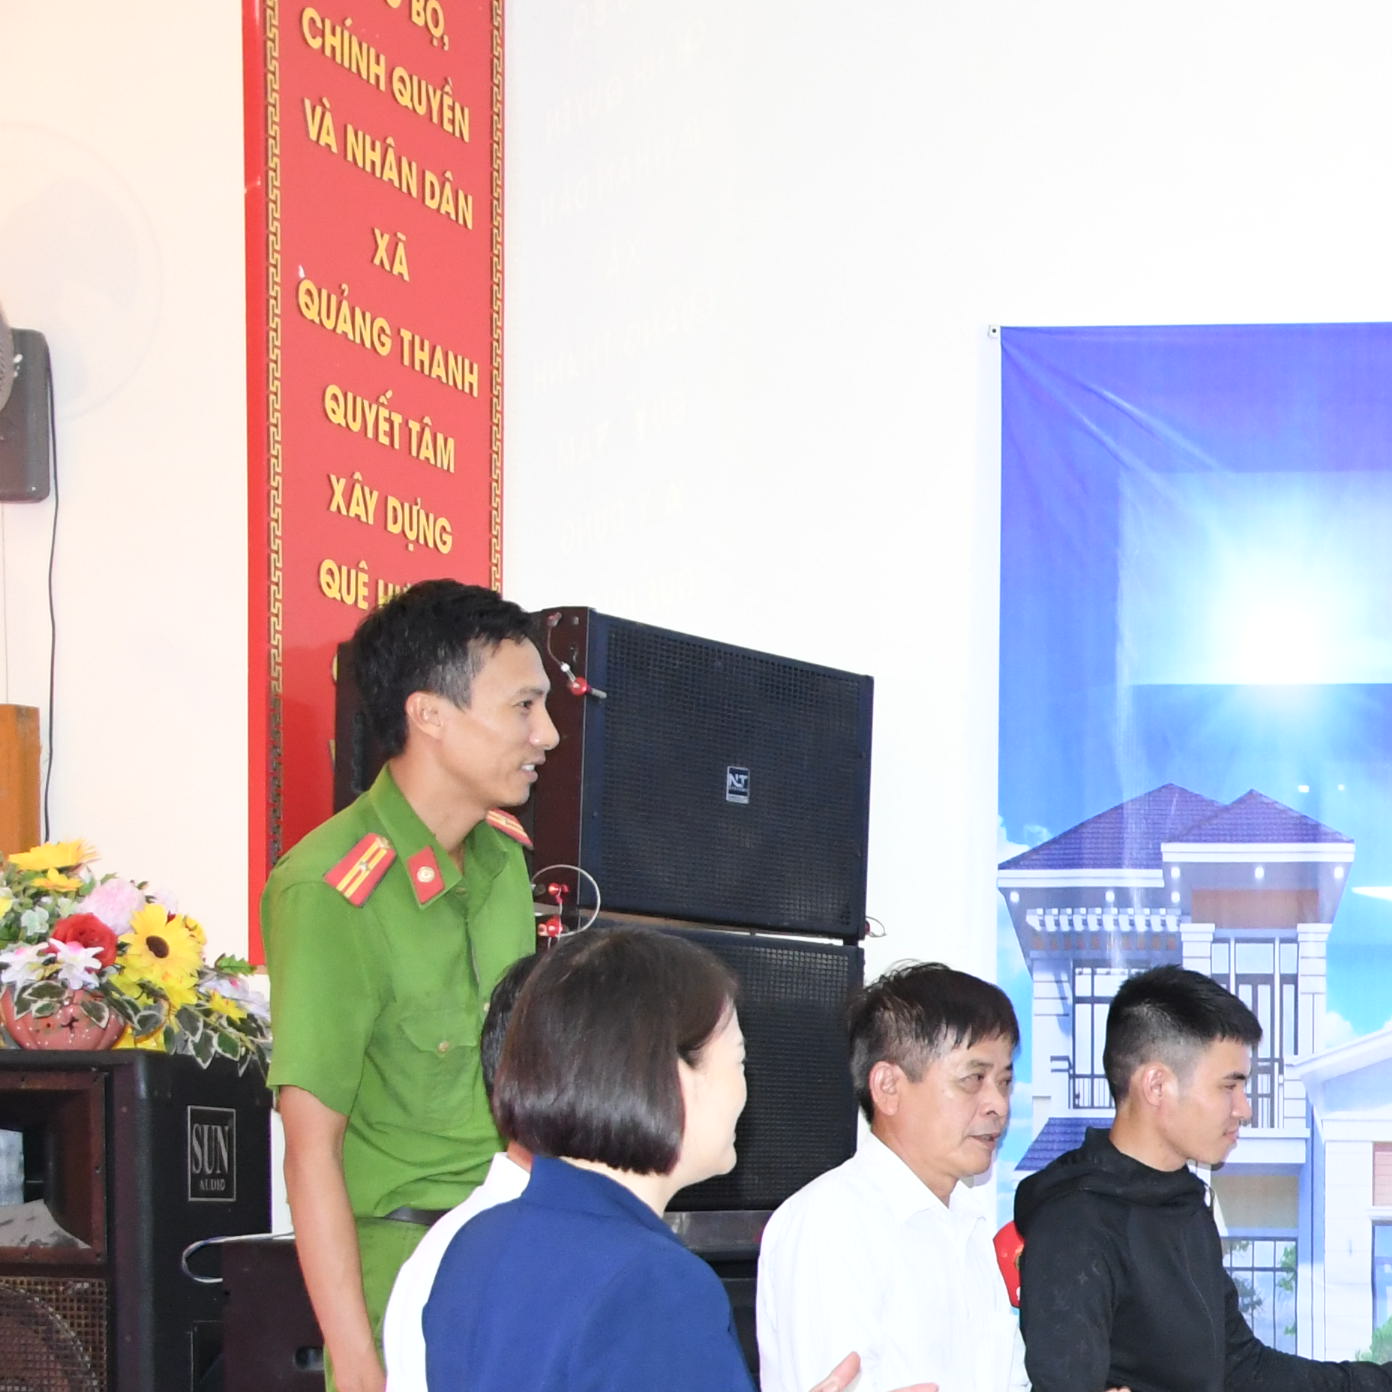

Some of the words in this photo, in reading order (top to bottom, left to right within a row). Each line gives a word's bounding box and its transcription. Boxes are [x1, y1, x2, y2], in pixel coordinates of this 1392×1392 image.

[301, 7, 386, 92] CHÍNH
[392, 67, 470, 143] QUYỀN
[304, 97, 338, 154] VÀ
[346, 124, 418, 199] NHÂN
[424, 171, 474, 230] DÂN
[373, 228, 411, 282] XÃ
[298, 279, 393, 357] QUẢNG
[399, 329, 479, 398] THANH
[324, 384, 403, 449] QUYẾT
[408, 417, 456, 473] TÂM
[329, 472, 380, 525] XÂY
[386, 496, 453, 555] DỰNG
[319, 559, 369, 611] QUÊ
[192, 1123, 229, 1174] SUN
